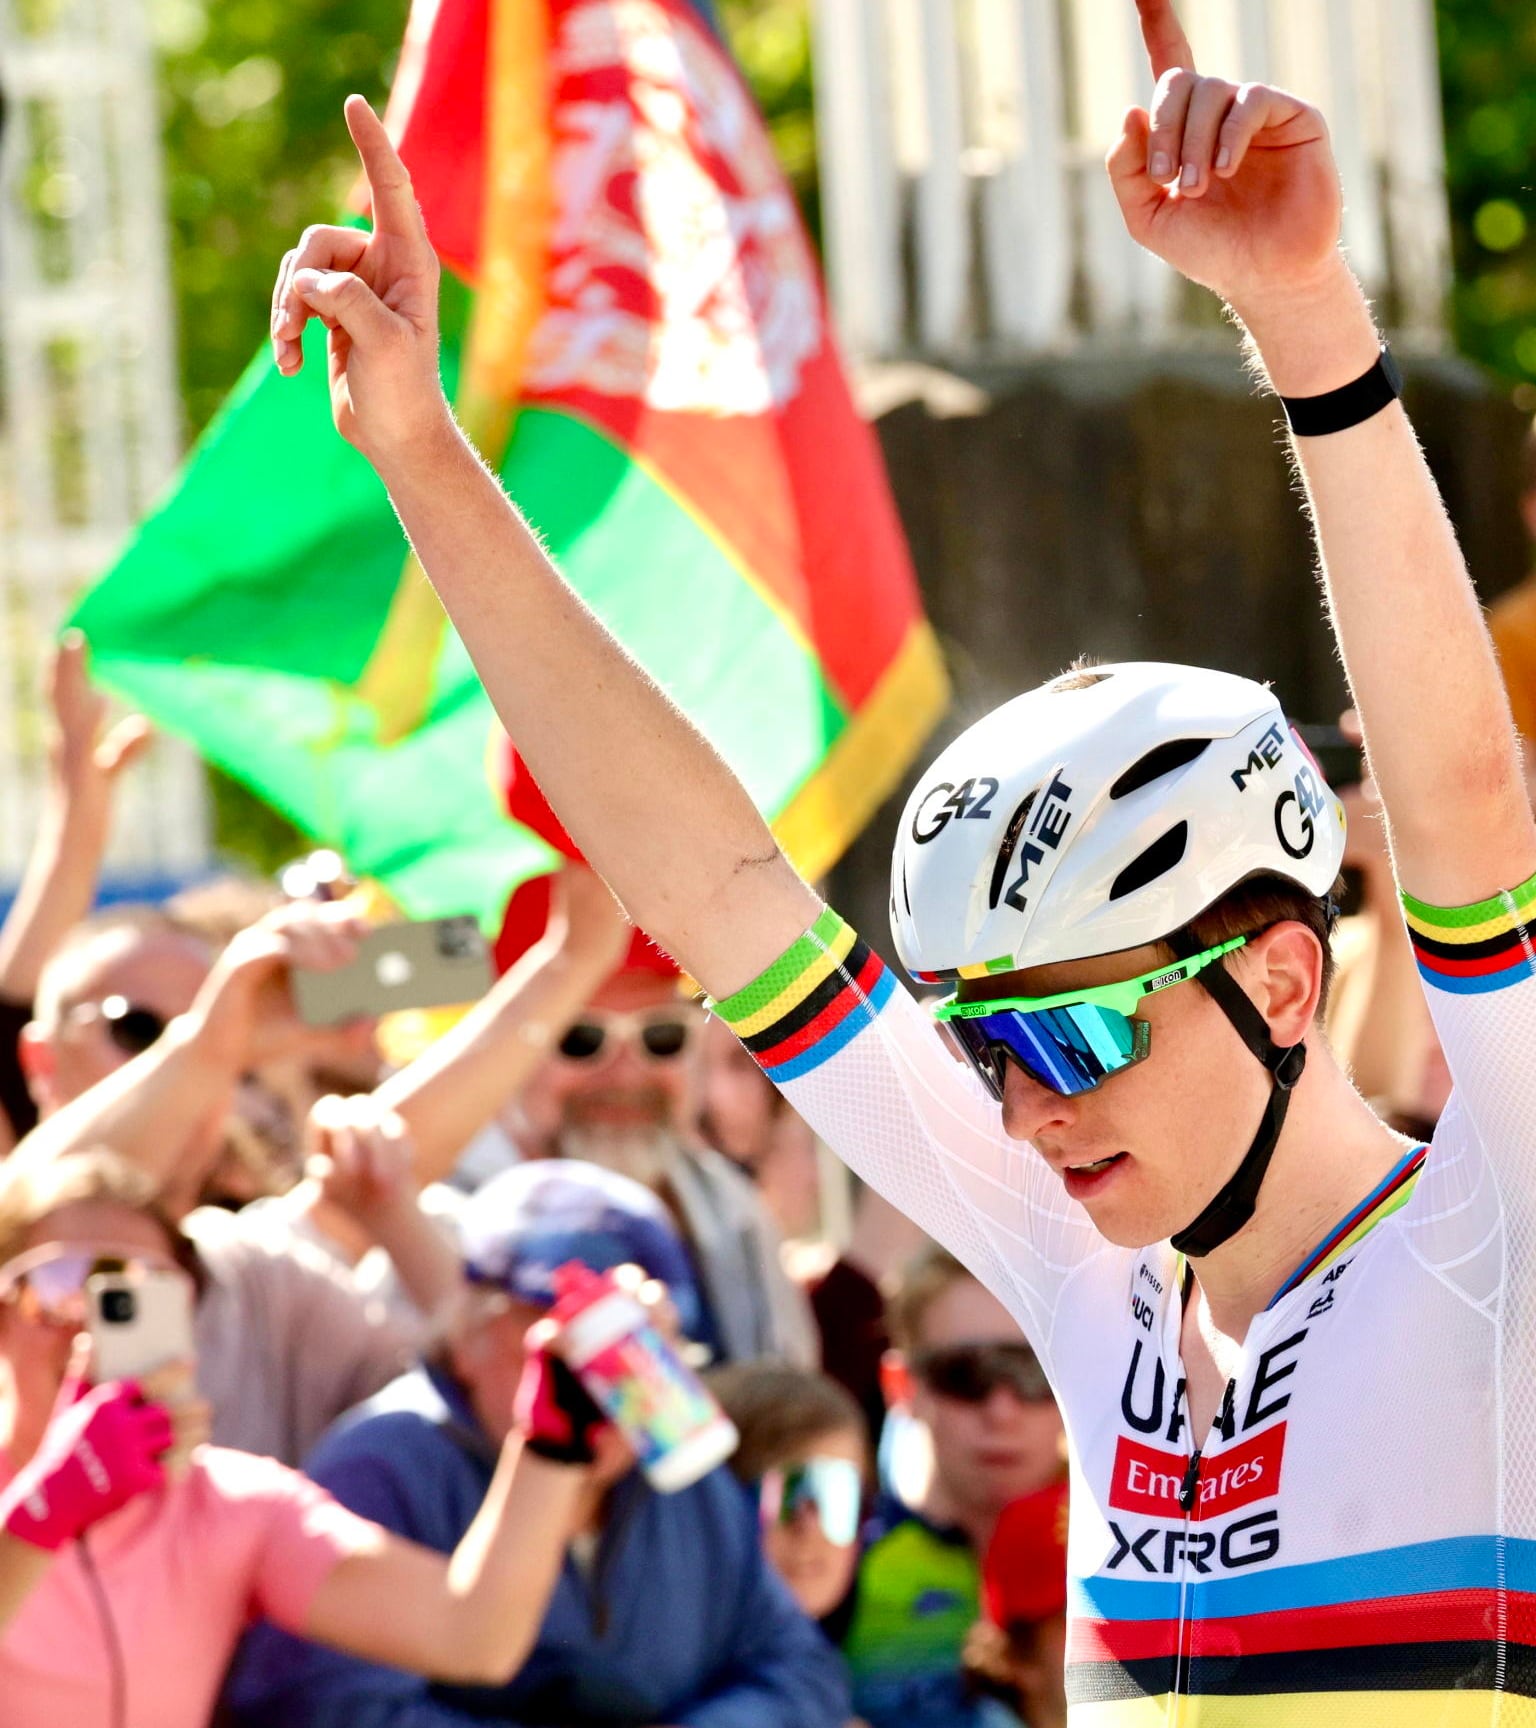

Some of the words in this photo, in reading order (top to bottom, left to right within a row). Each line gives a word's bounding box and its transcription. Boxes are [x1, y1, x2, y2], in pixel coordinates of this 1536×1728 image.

[1231, 722, 1284, 793] MET
[912, 777, 999, 845] G42
[1004, 768, 1072, 913] MET
[1274, 765, 1325, 860] G42
[1134, 1296, 1154, 1332] UCI
[1121, 1327, 1309, 1443] UAE
[1127, 1456, 1264, 1503] Emates
[1107, 1510, 1280, 1574] XRG
